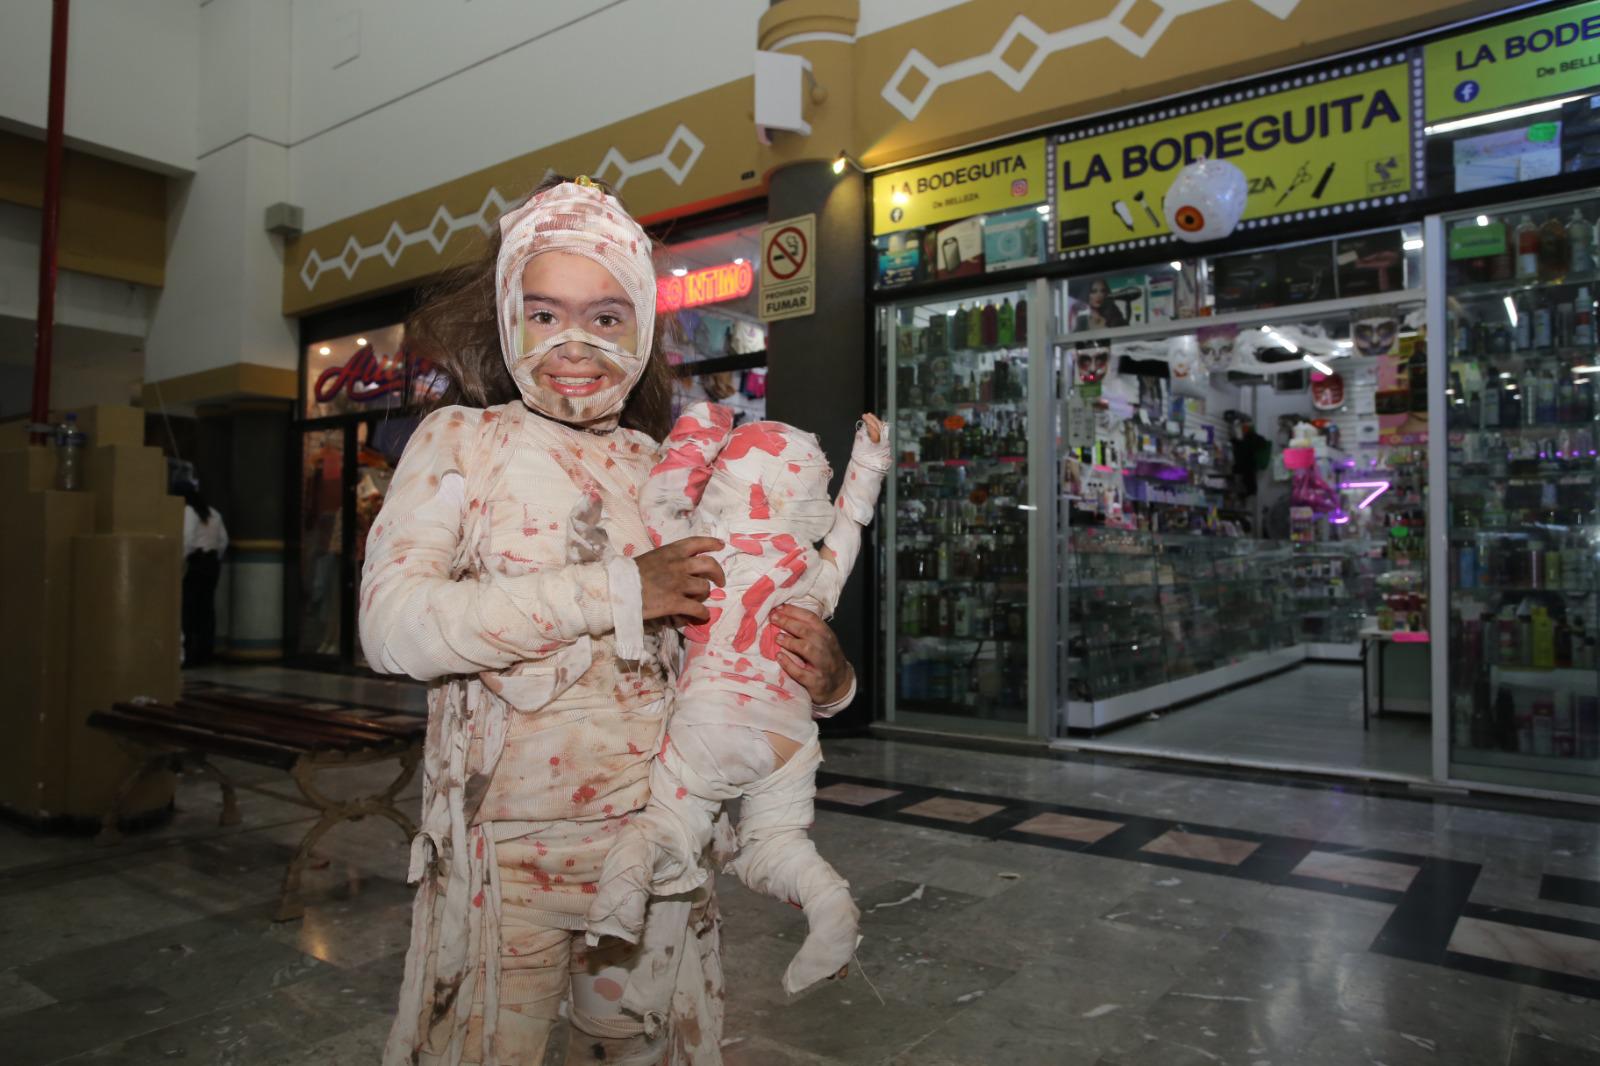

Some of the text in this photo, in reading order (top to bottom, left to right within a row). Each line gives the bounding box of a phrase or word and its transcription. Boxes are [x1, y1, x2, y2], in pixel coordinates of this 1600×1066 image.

[1456, 44, 1497, 71] LA
[1536, 54, 1600, 78] De BELL
[1063, 88, 1401, 191] LA BODEGUITA
[917, 155, 1027, 194] BODEGUITA
[766, 296, 807, 312] FUMAR
